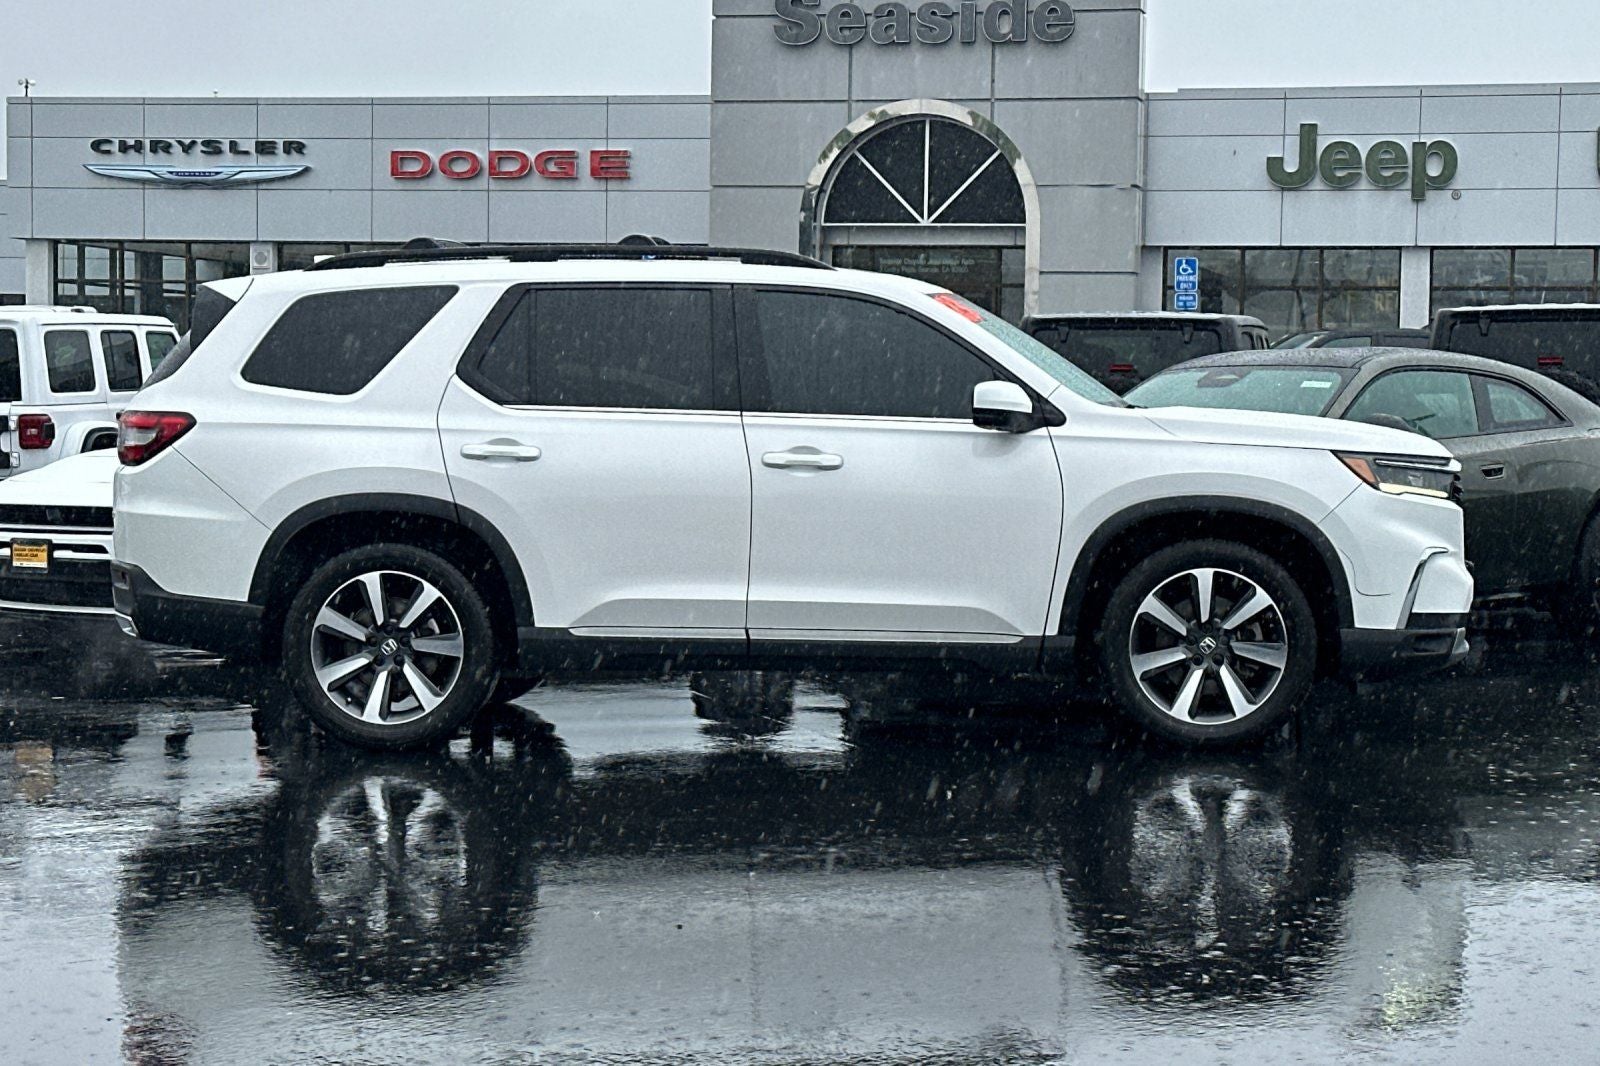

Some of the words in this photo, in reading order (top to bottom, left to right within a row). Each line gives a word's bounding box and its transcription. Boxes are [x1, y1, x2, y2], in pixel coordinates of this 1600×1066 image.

[773, 0, 1075, 46] Seaside
[90, 138, 306, 155] CHRYSLER
[390, 150, 630, 179] DODGE
[1266, 123, 1459, 201] Jeep
